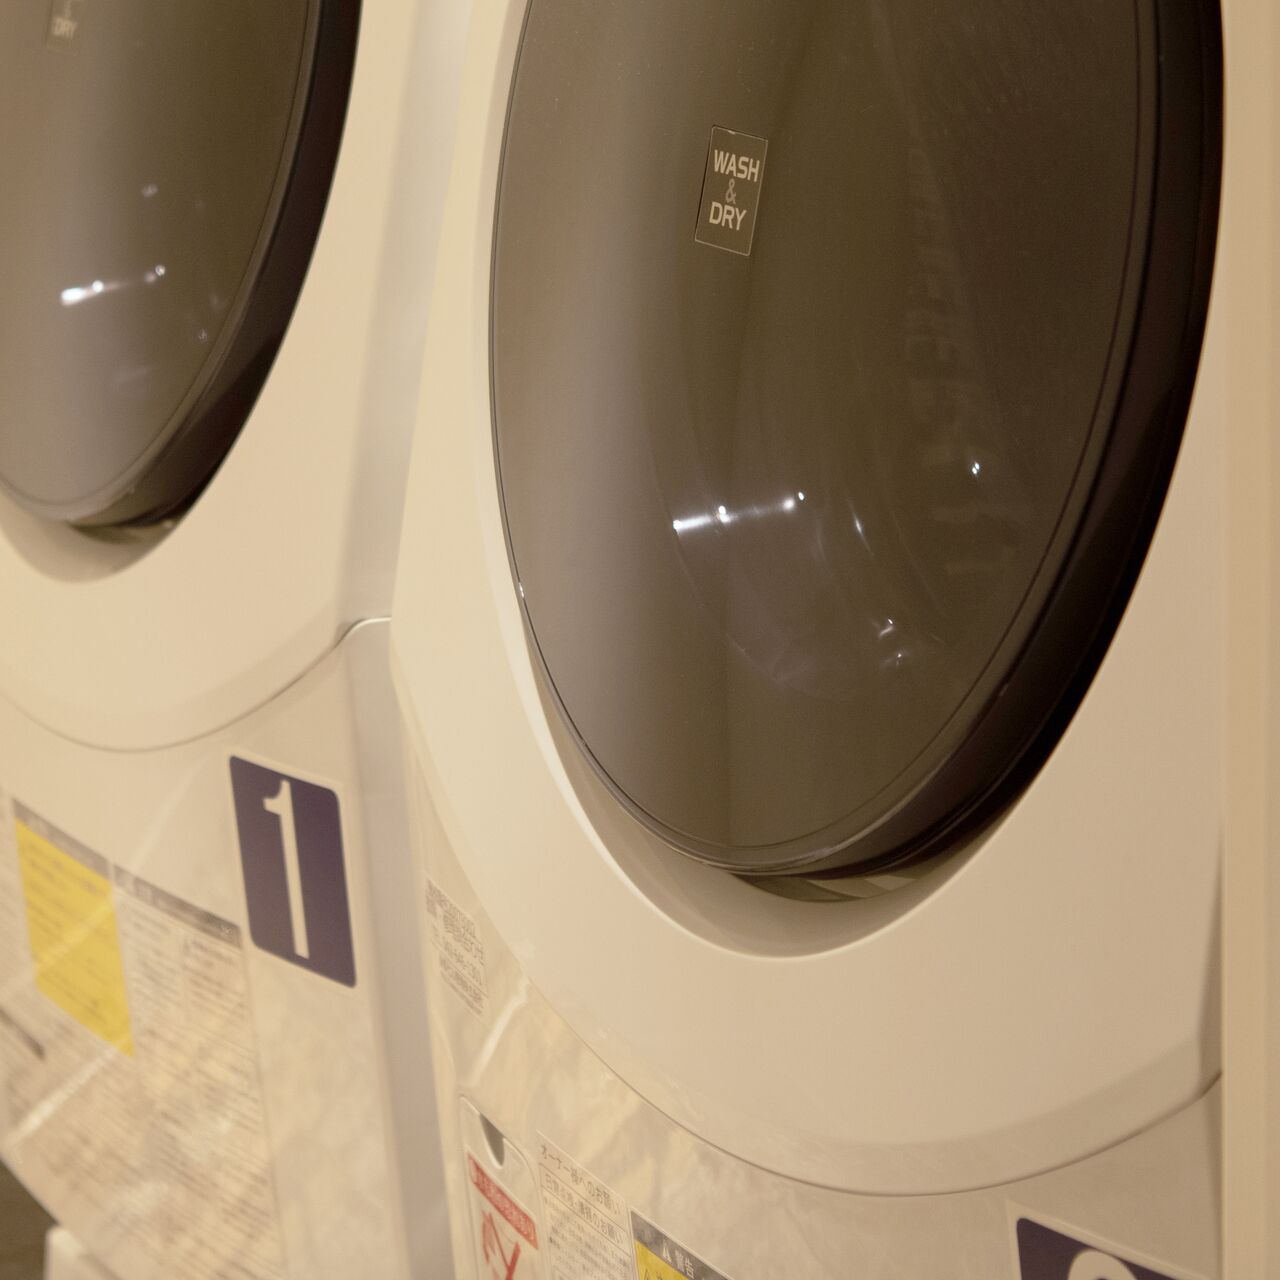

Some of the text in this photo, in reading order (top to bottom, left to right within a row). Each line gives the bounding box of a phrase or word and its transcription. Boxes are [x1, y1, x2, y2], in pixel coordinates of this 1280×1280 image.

[713, 149, 761, 183] WASH
[725, 178, 737, 204] &
[708, 201, 748, 231] DRY
[262, 779, 312, 960] 1
